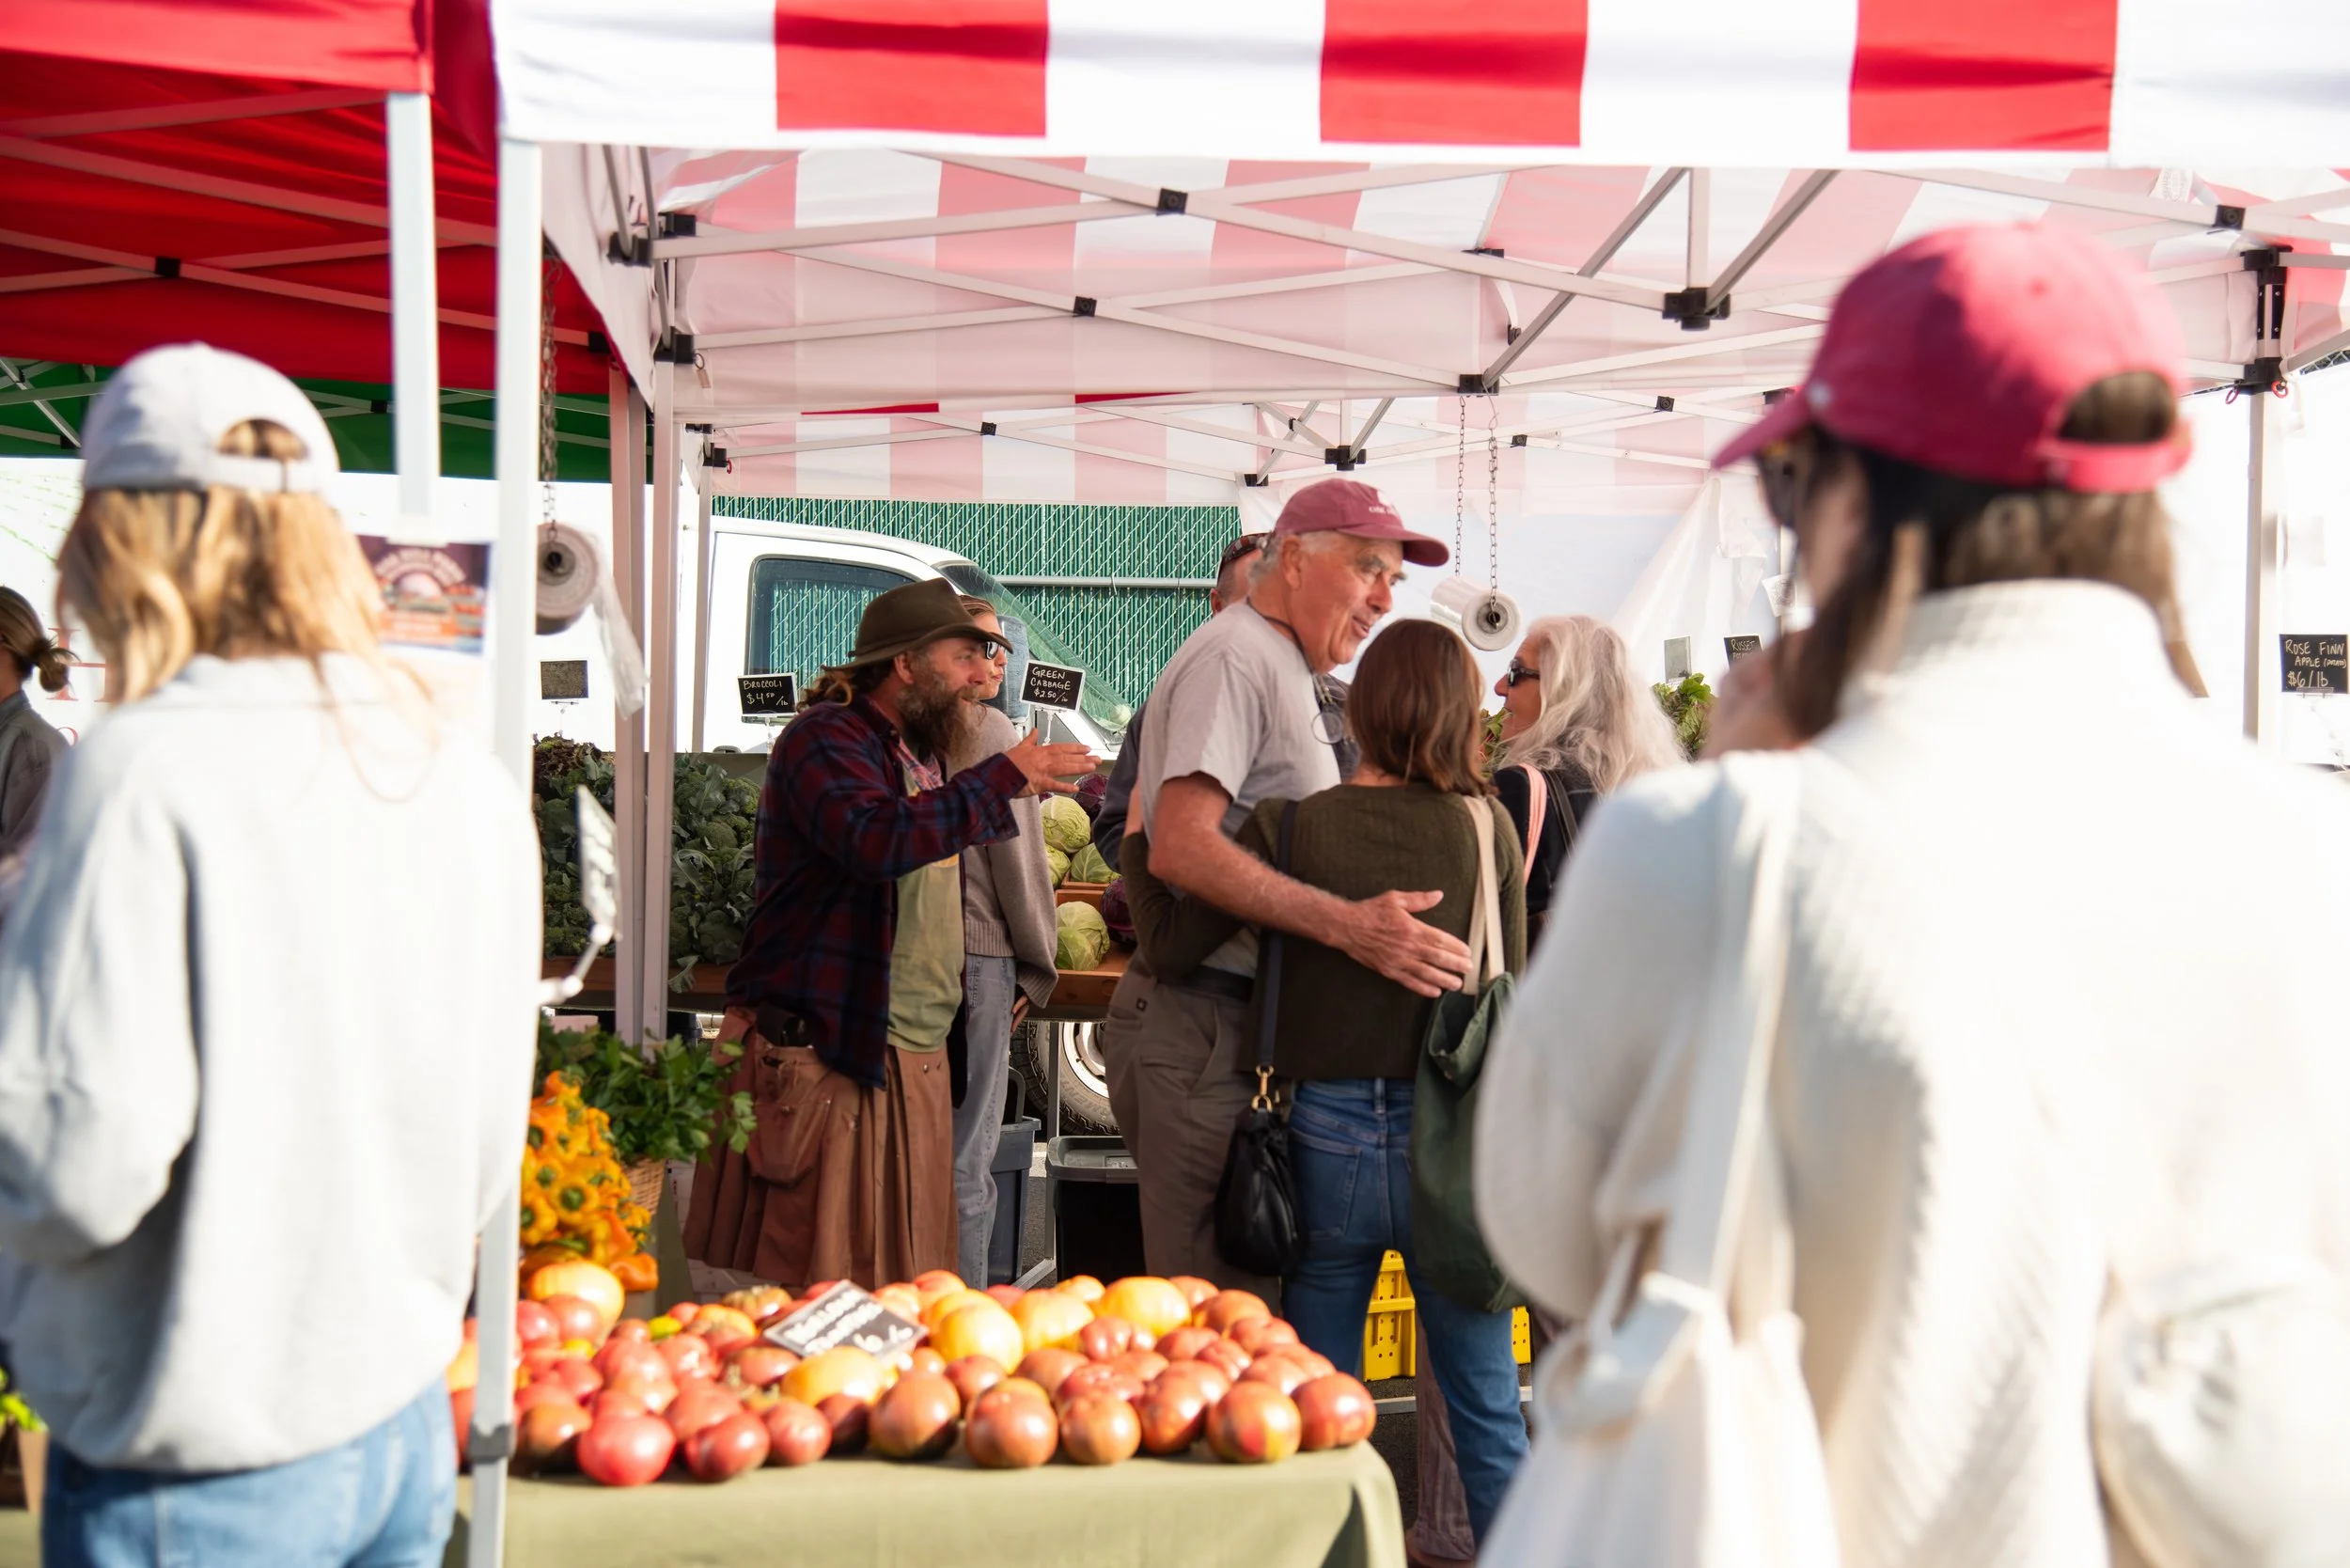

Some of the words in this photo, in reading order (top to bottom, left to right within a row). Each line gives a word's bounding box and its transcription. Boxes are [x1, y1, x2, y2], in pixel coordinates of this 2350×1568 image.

[1731, 639, 1755, 651] RUSSET
[2285, 639, 2311, 655] ROSE
[2319, 641, 2345, 655] FINN
[2295, 655, 2321, 667] APPLE
[1032, 666, 1066, 679] GREEN
[743, 680, 782, 690] BROCCOLI
[1030, 677, 1071, 690] CABBAGE
